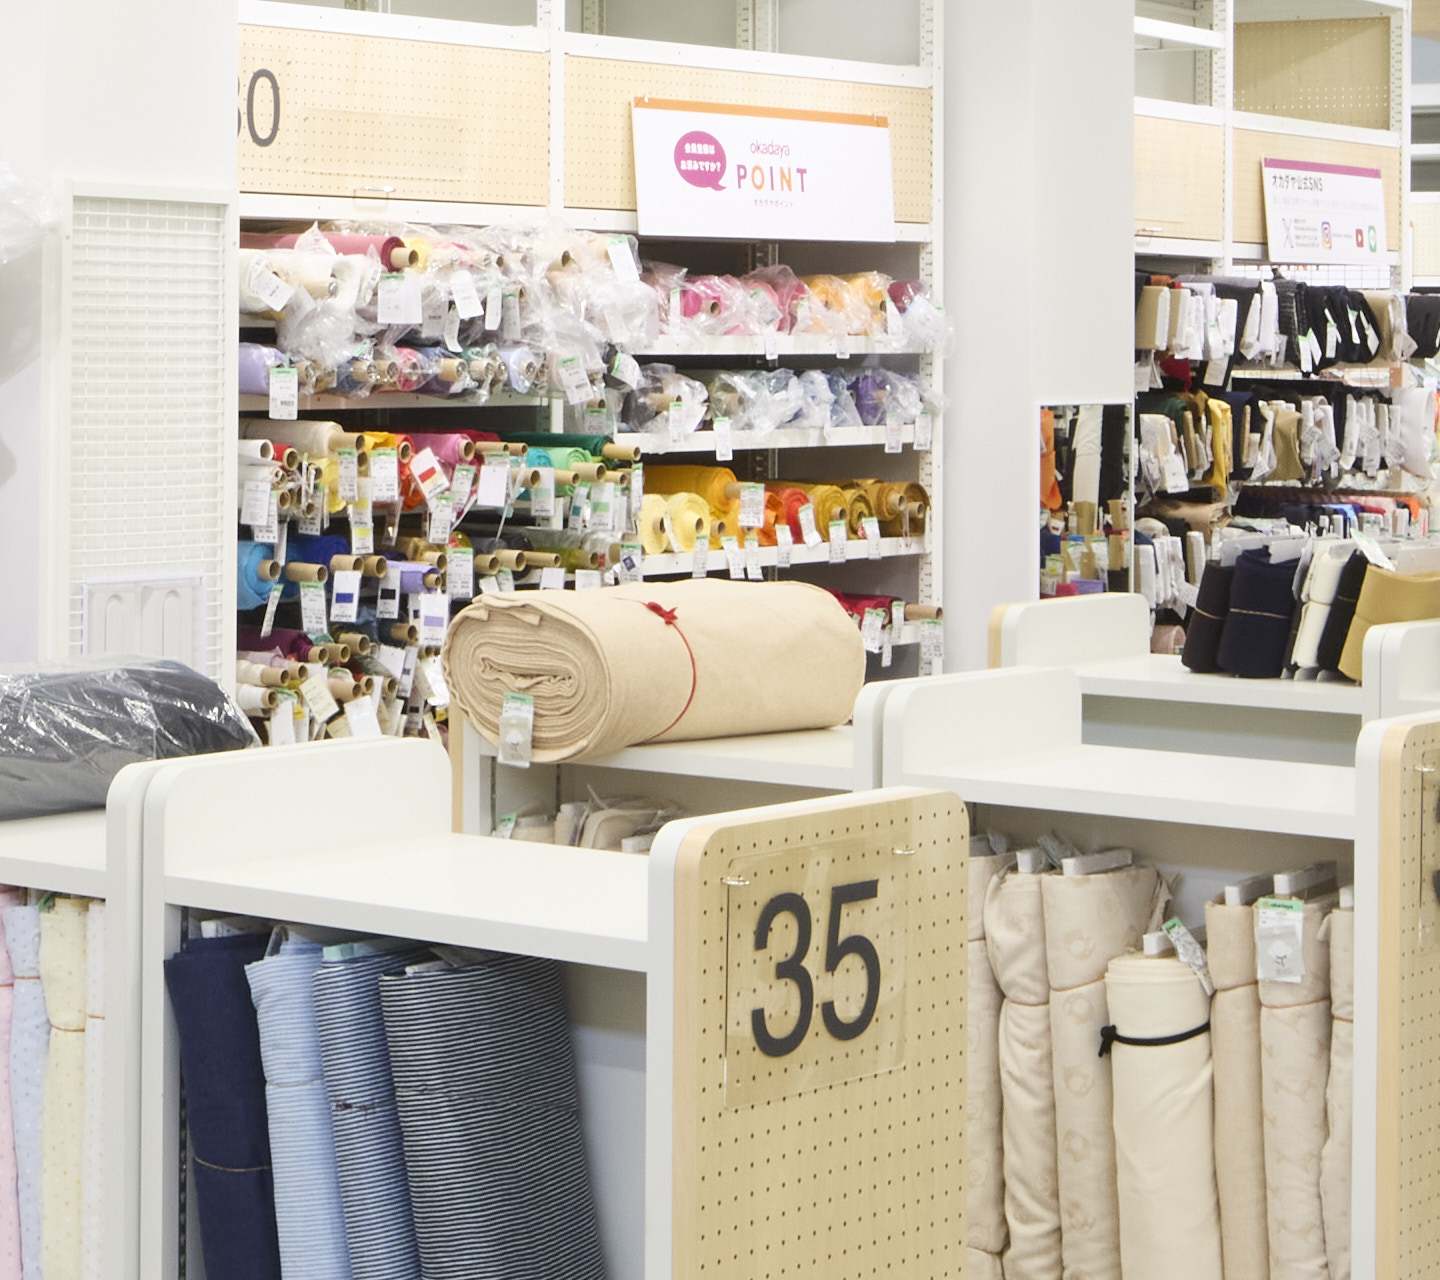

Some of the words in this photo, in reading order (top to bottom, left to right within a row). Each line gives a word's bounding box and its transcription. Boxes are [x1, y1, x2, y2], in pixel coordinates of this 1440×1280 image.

[237, 68, 281, 147] 0
[750, 138, 790, 159] okadaya
[736, 164, 808, 192] POINT
[751, 879, 881, 1057] 35
